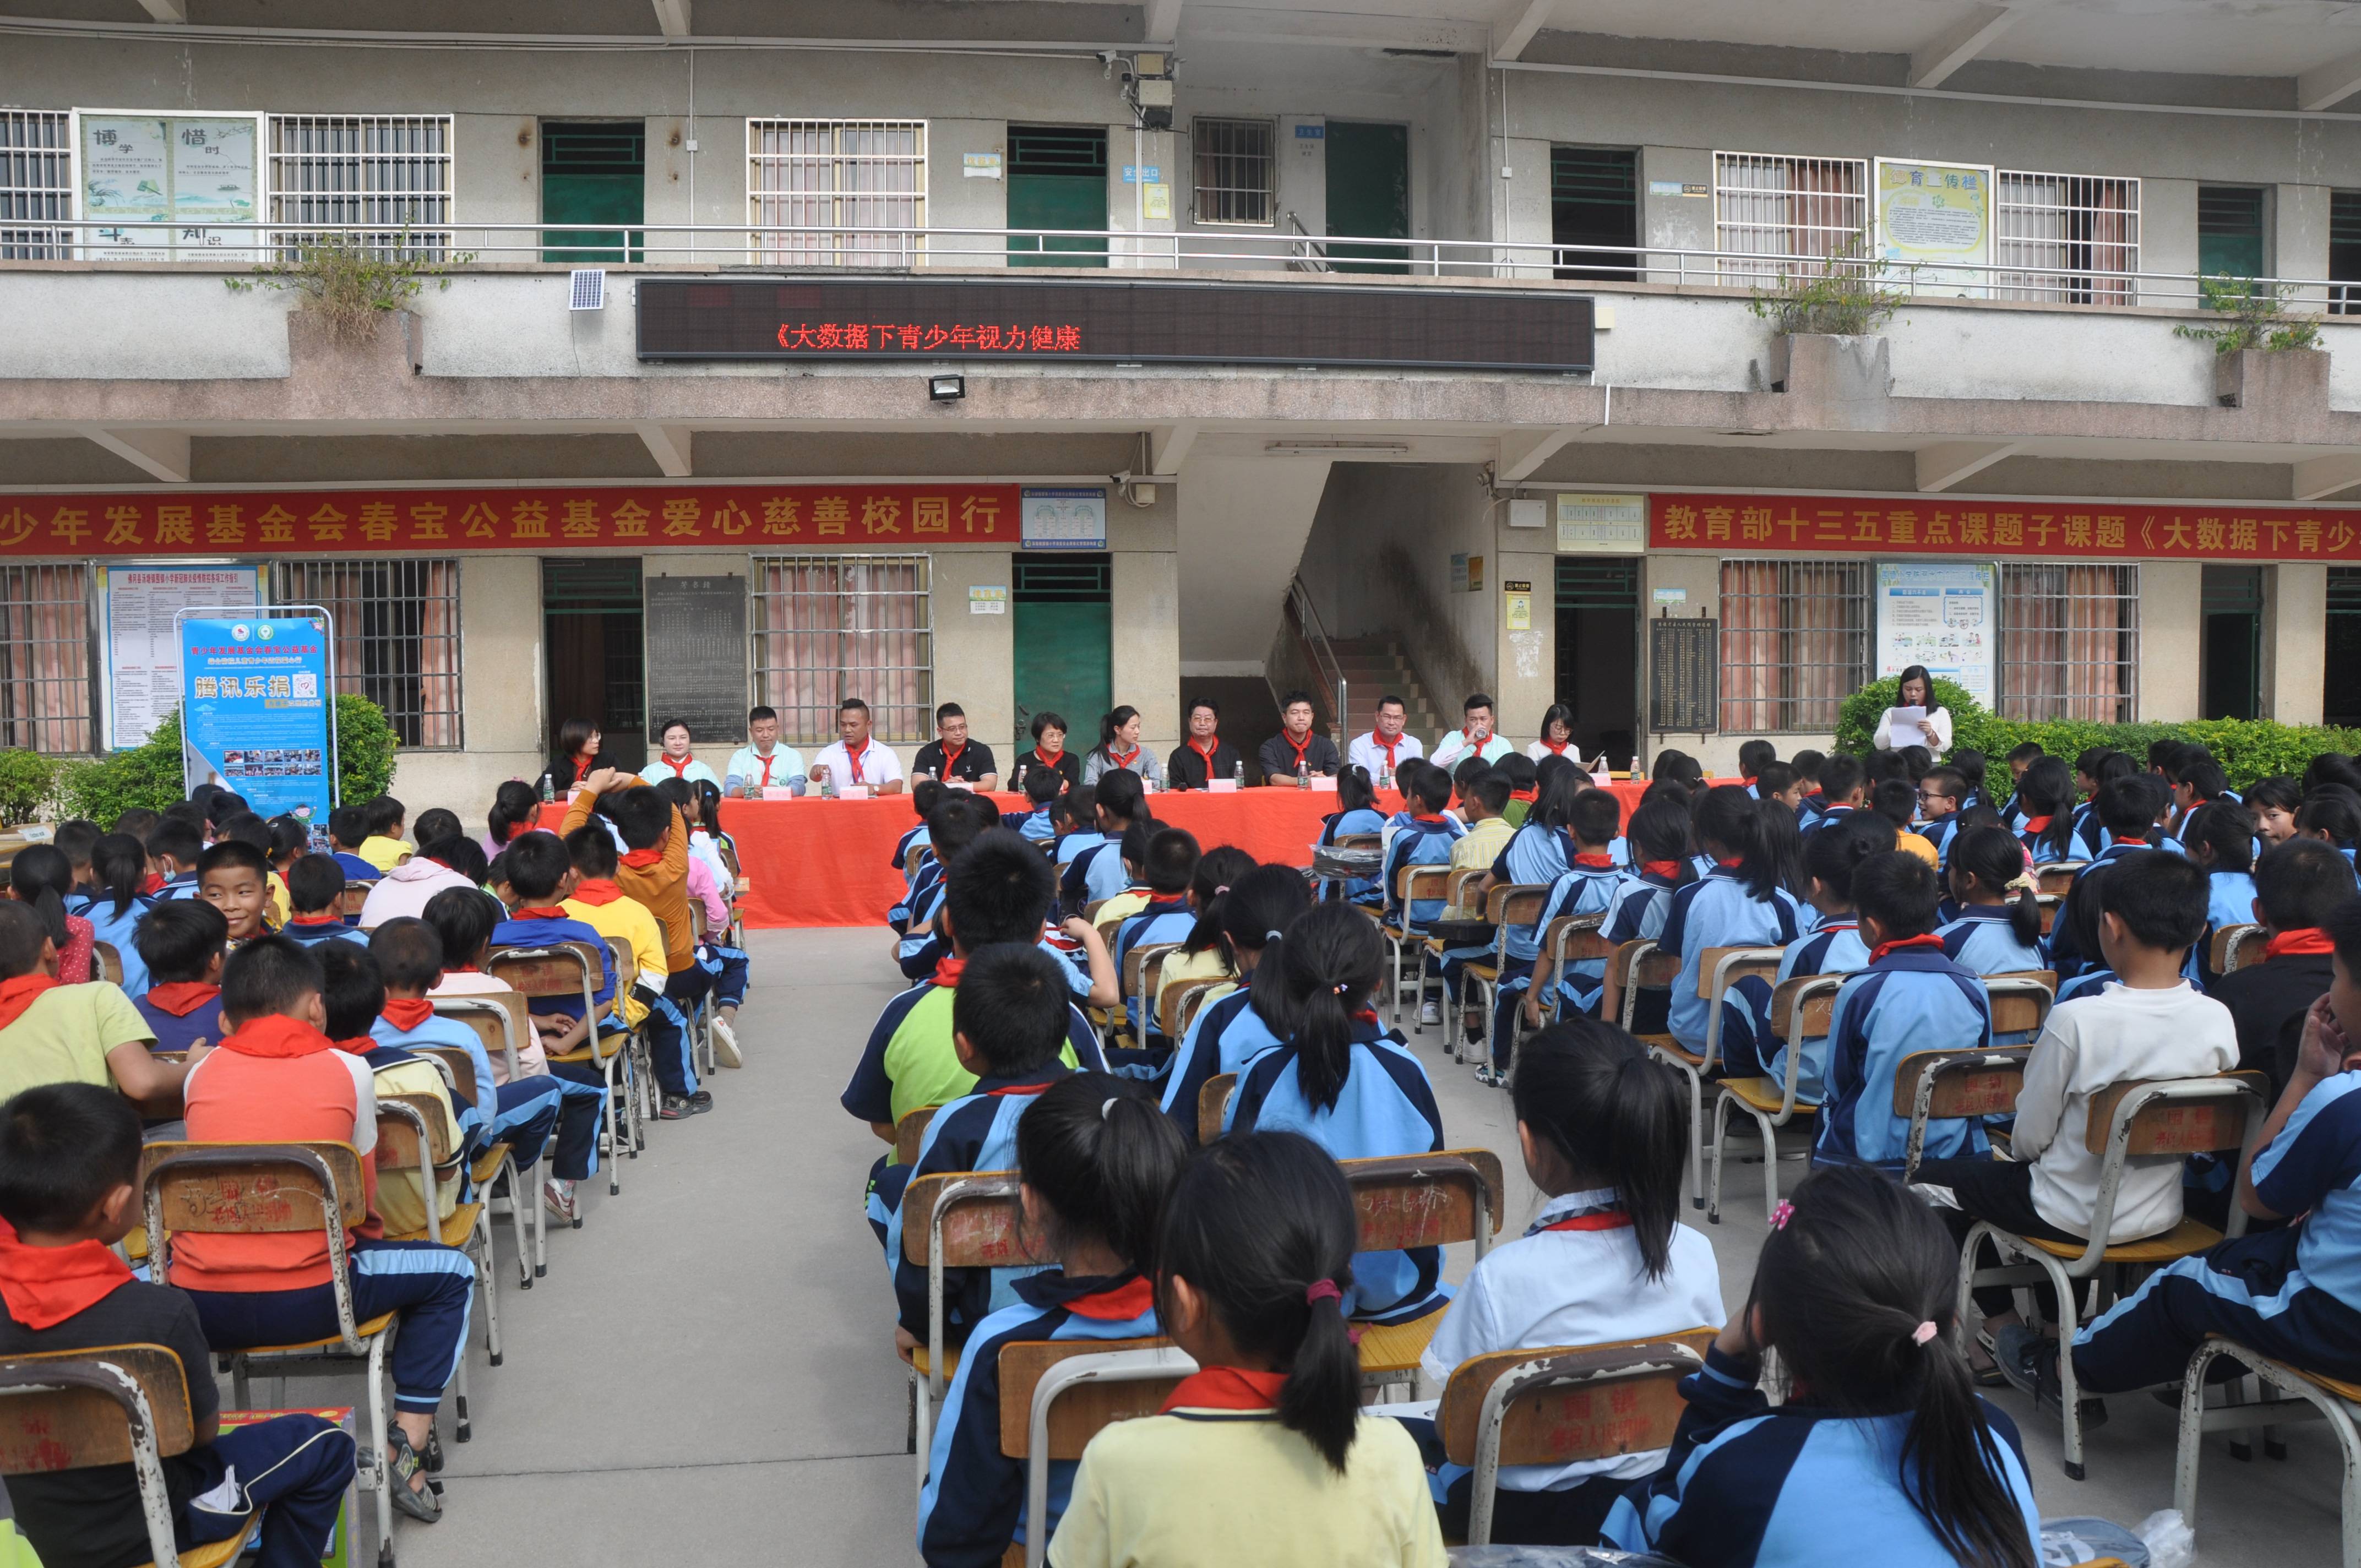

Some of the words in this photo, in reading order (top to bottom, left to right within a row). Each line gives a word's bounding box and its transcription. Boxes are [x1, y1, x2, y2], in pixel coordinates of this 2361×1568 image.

[777, 323, 1080, 351] 《大数据下青少年视力健康
[0, 496, 1000, 546] 少年发展基金会春宝公益基金爱心慈善校园行
[1664, 505, 2360, 553] 教育部十三五重点课题子课题《大数据下青少
[191, 646, 317, 655] 青少年发展基金会春宝公益基金
[194, 675, 290, 699] 腾讯乐捐
